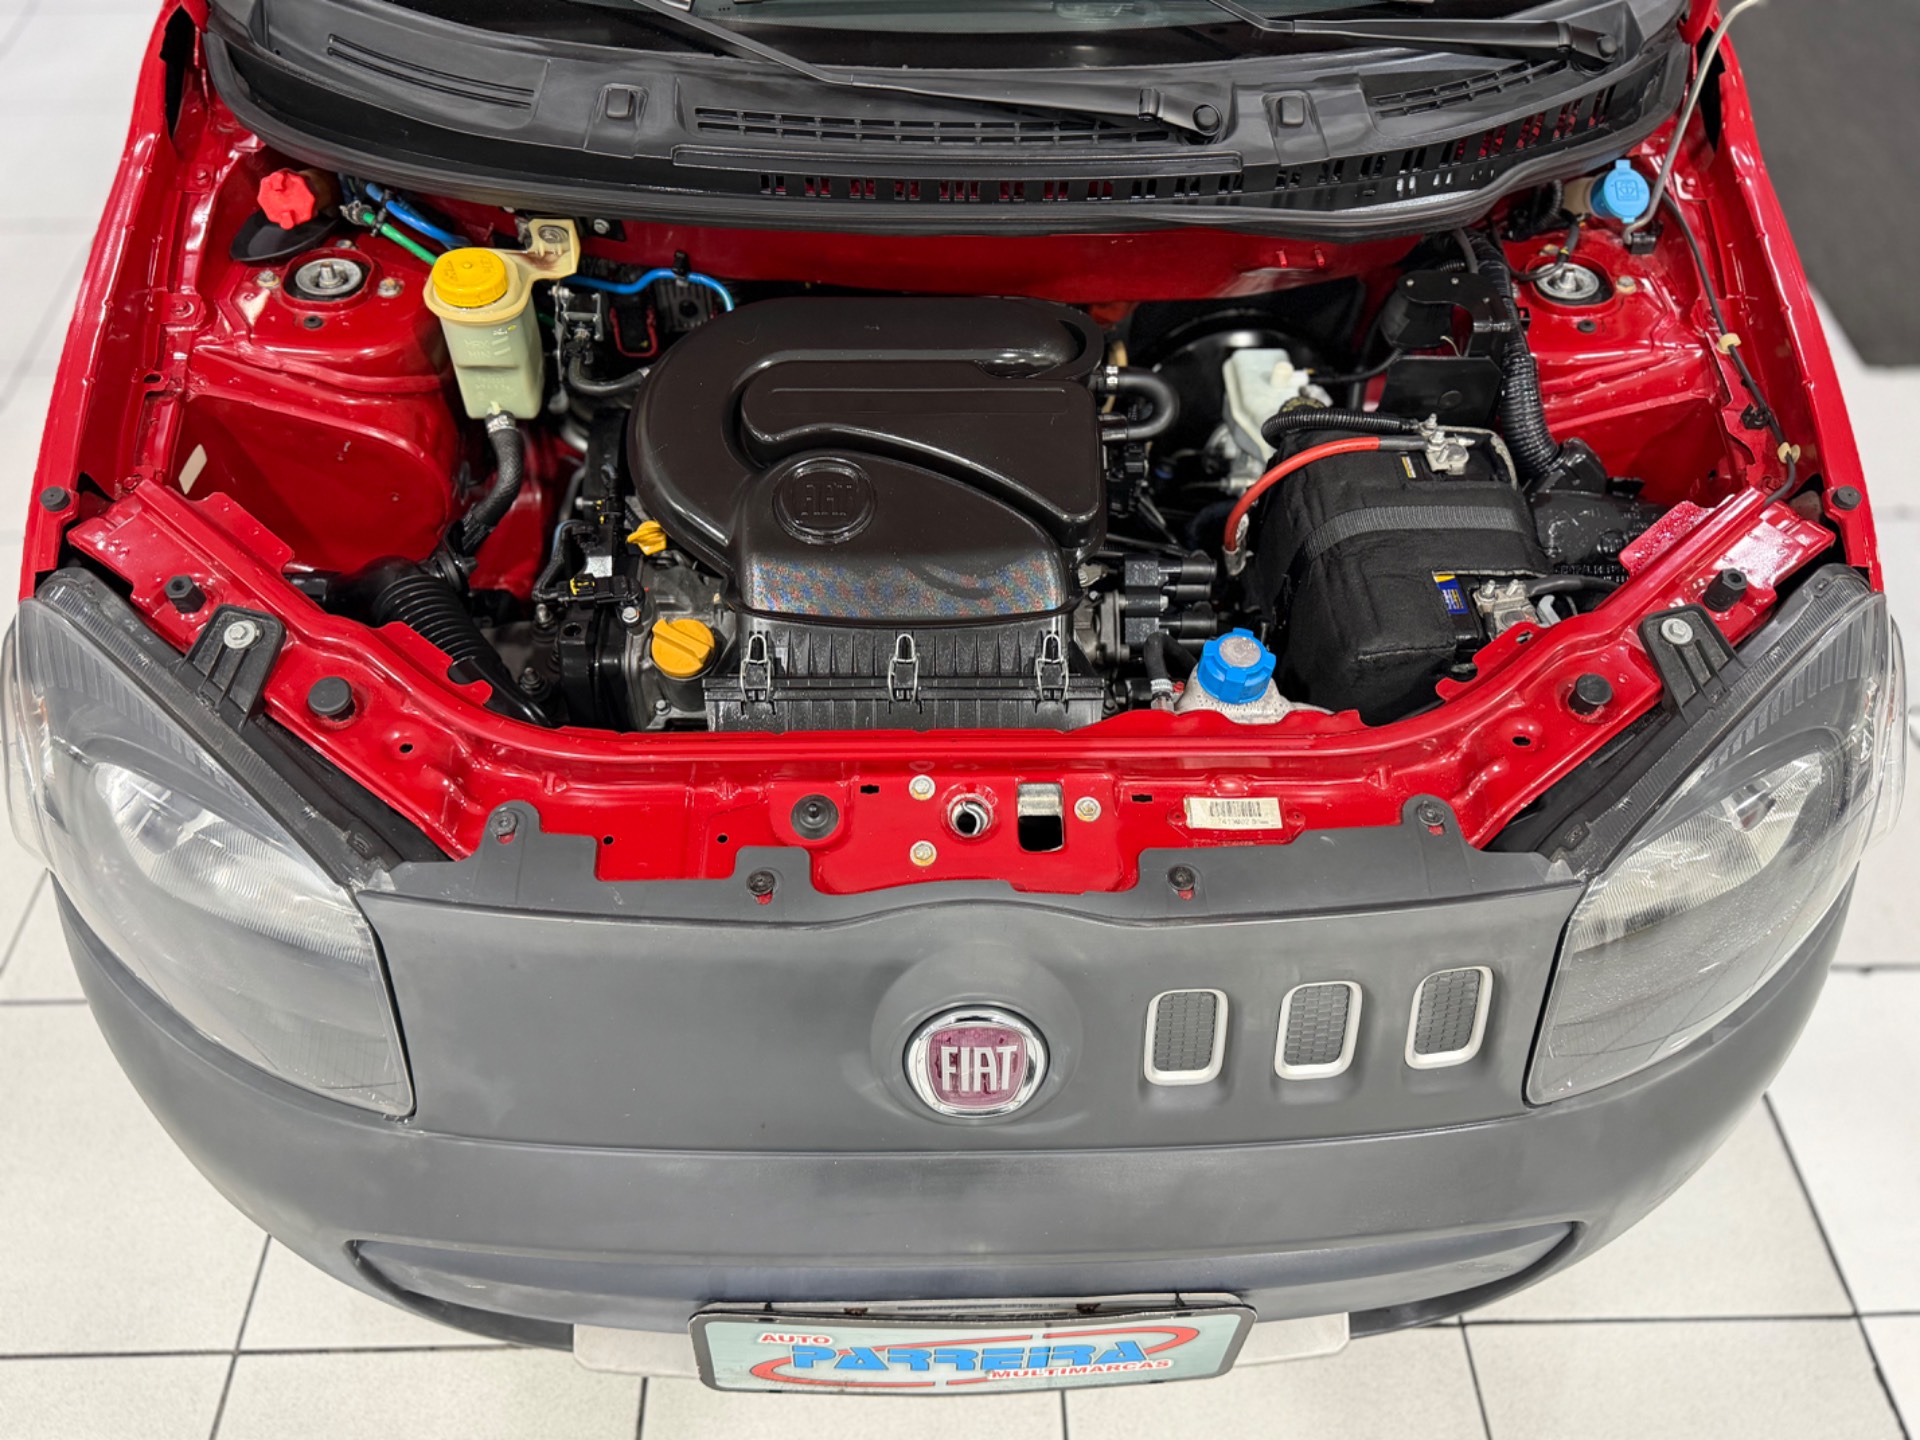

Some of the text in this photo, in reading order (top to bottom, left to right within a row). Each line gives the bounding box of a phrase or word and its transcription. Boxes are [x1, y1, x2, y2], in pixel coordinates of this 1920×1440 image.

[940, 1045, 1018, 1092] FIAT
[761, 1333, 831, 1345] AUTO
[791, 1340, 1148, 1371] PARREIRA
[990, 1359, 1170, 1379] MULTIMARCAS
